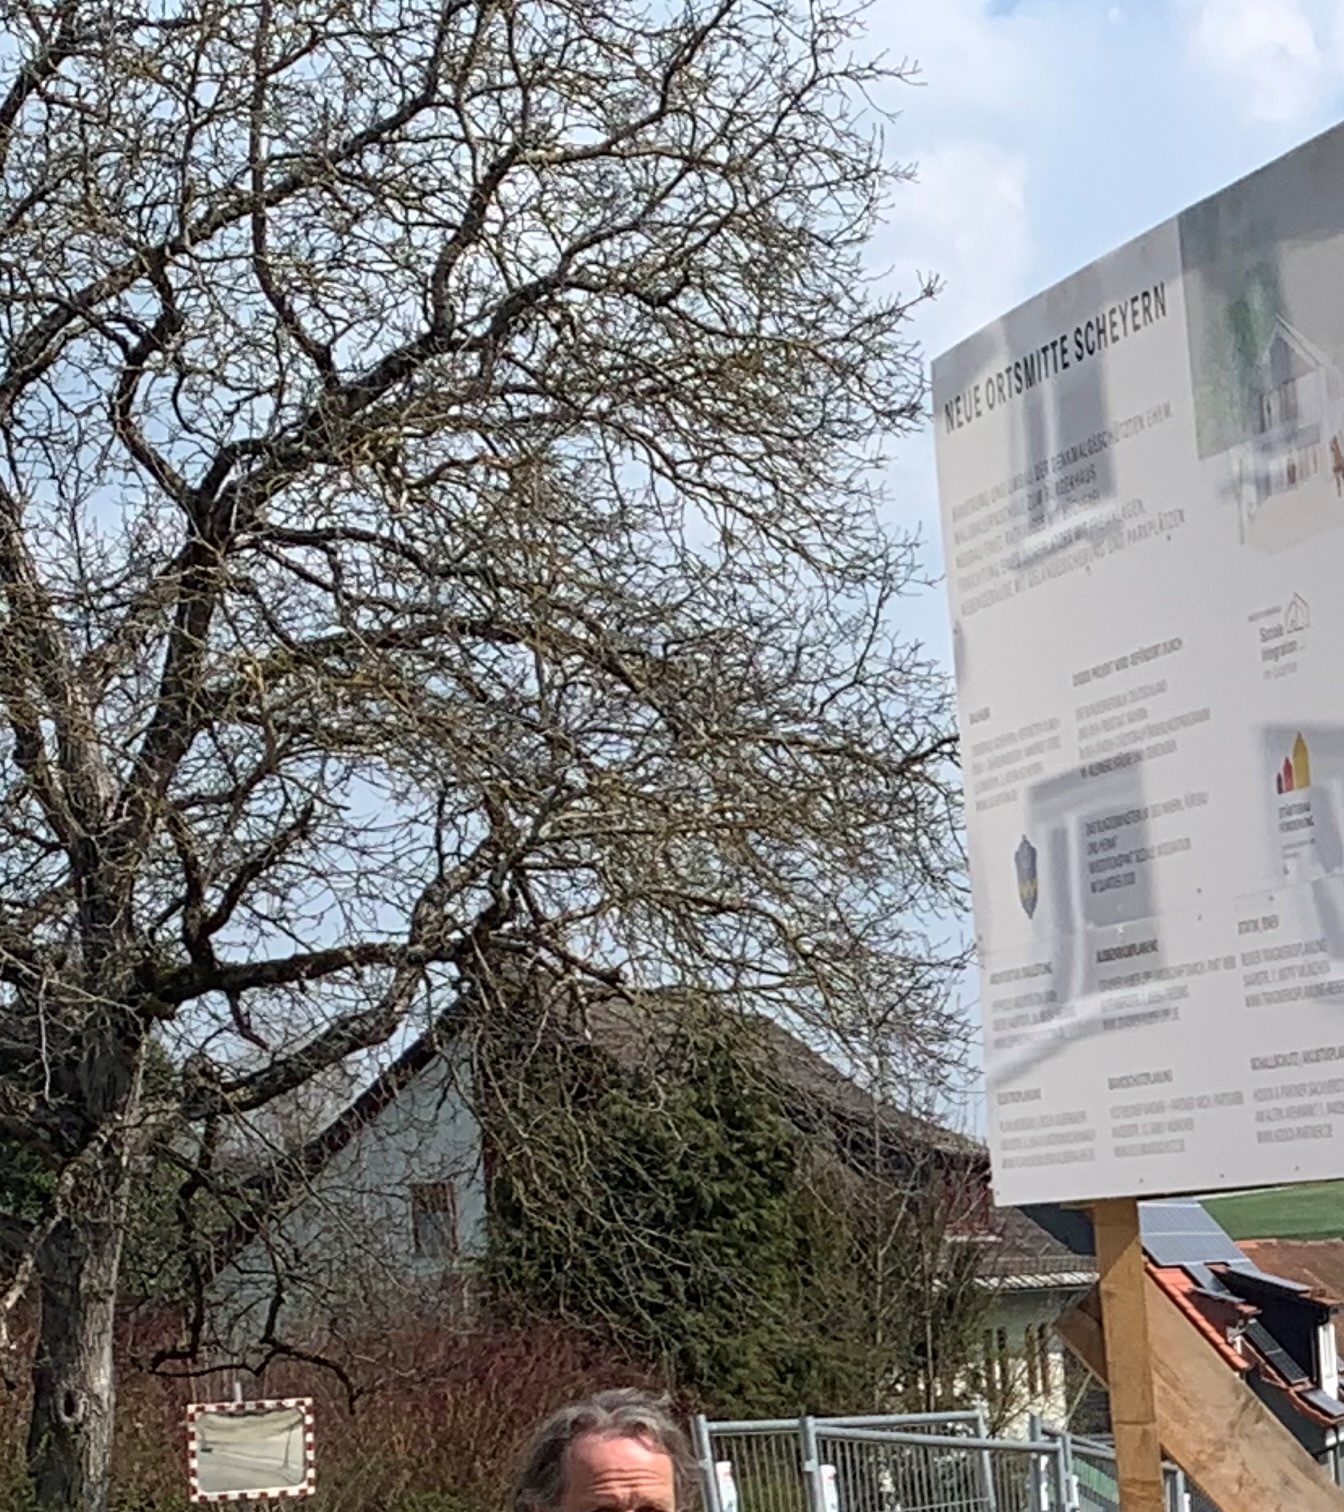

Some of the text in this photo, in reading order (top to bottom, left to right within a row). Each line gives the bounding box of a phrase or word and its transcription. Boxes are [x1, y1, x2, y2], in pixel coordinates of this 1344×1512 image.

[944, 281, 1167, 434] NEUE ORTSMITTE SCHEYERN
